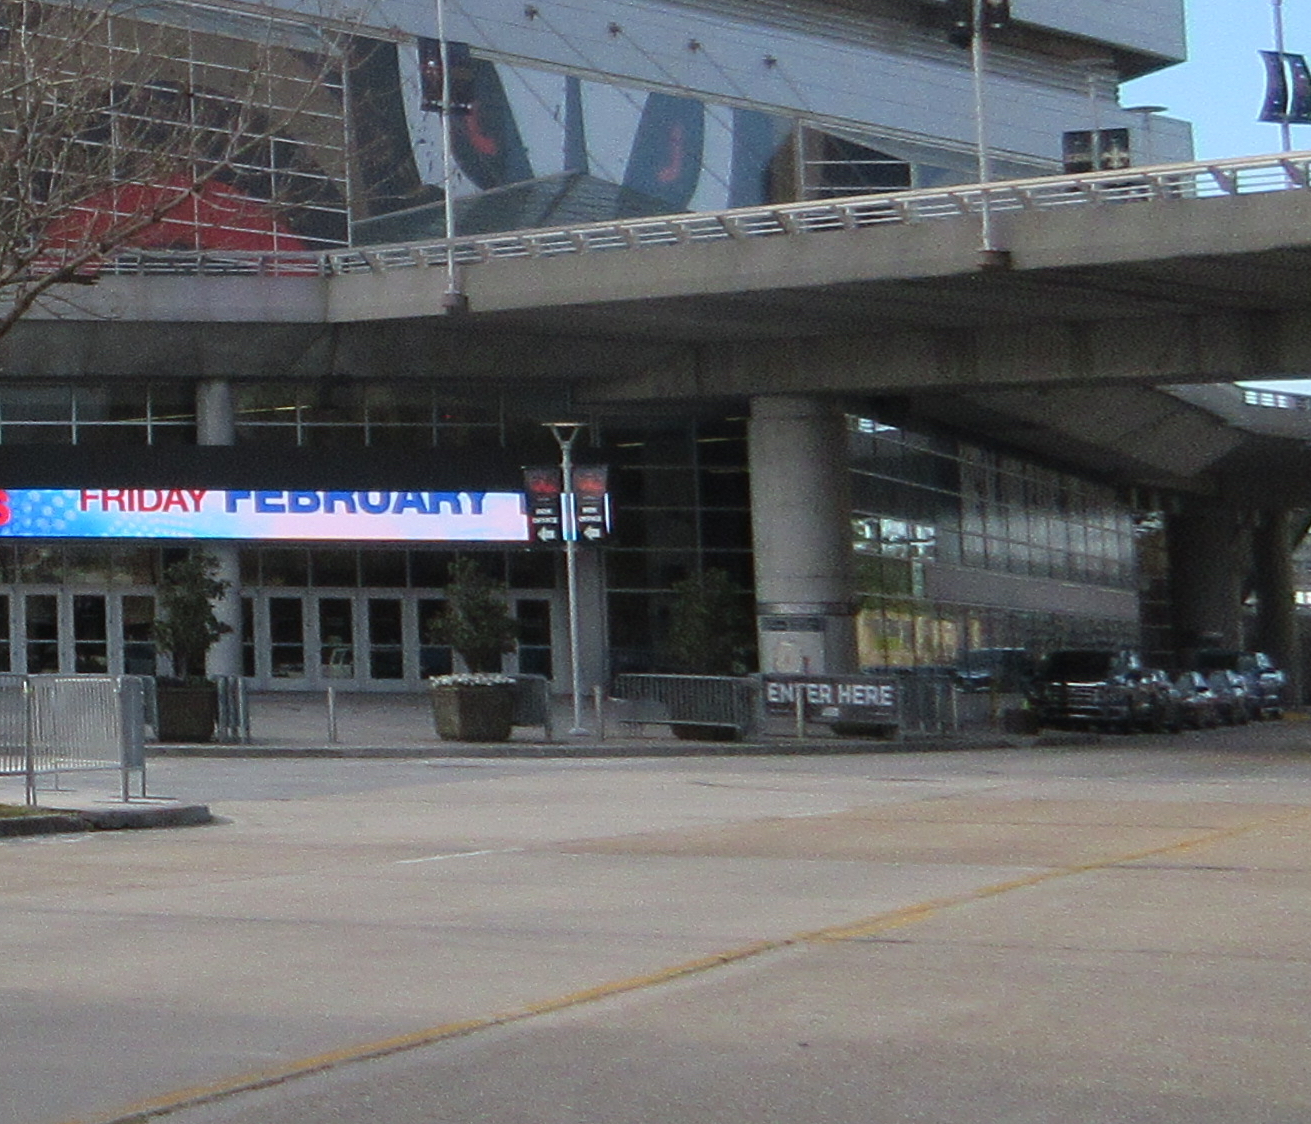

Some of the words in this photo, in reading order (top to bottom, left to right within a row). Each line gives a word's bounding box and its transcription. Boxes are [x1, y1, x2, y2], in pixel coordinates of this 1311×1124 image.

[79, 489, 209, 513] FRIDAY
[225, 490, 487, 515] FEBRUARY
[767, 682, 832, 704] ENTER
[838, 684, 894, 706] HERE
